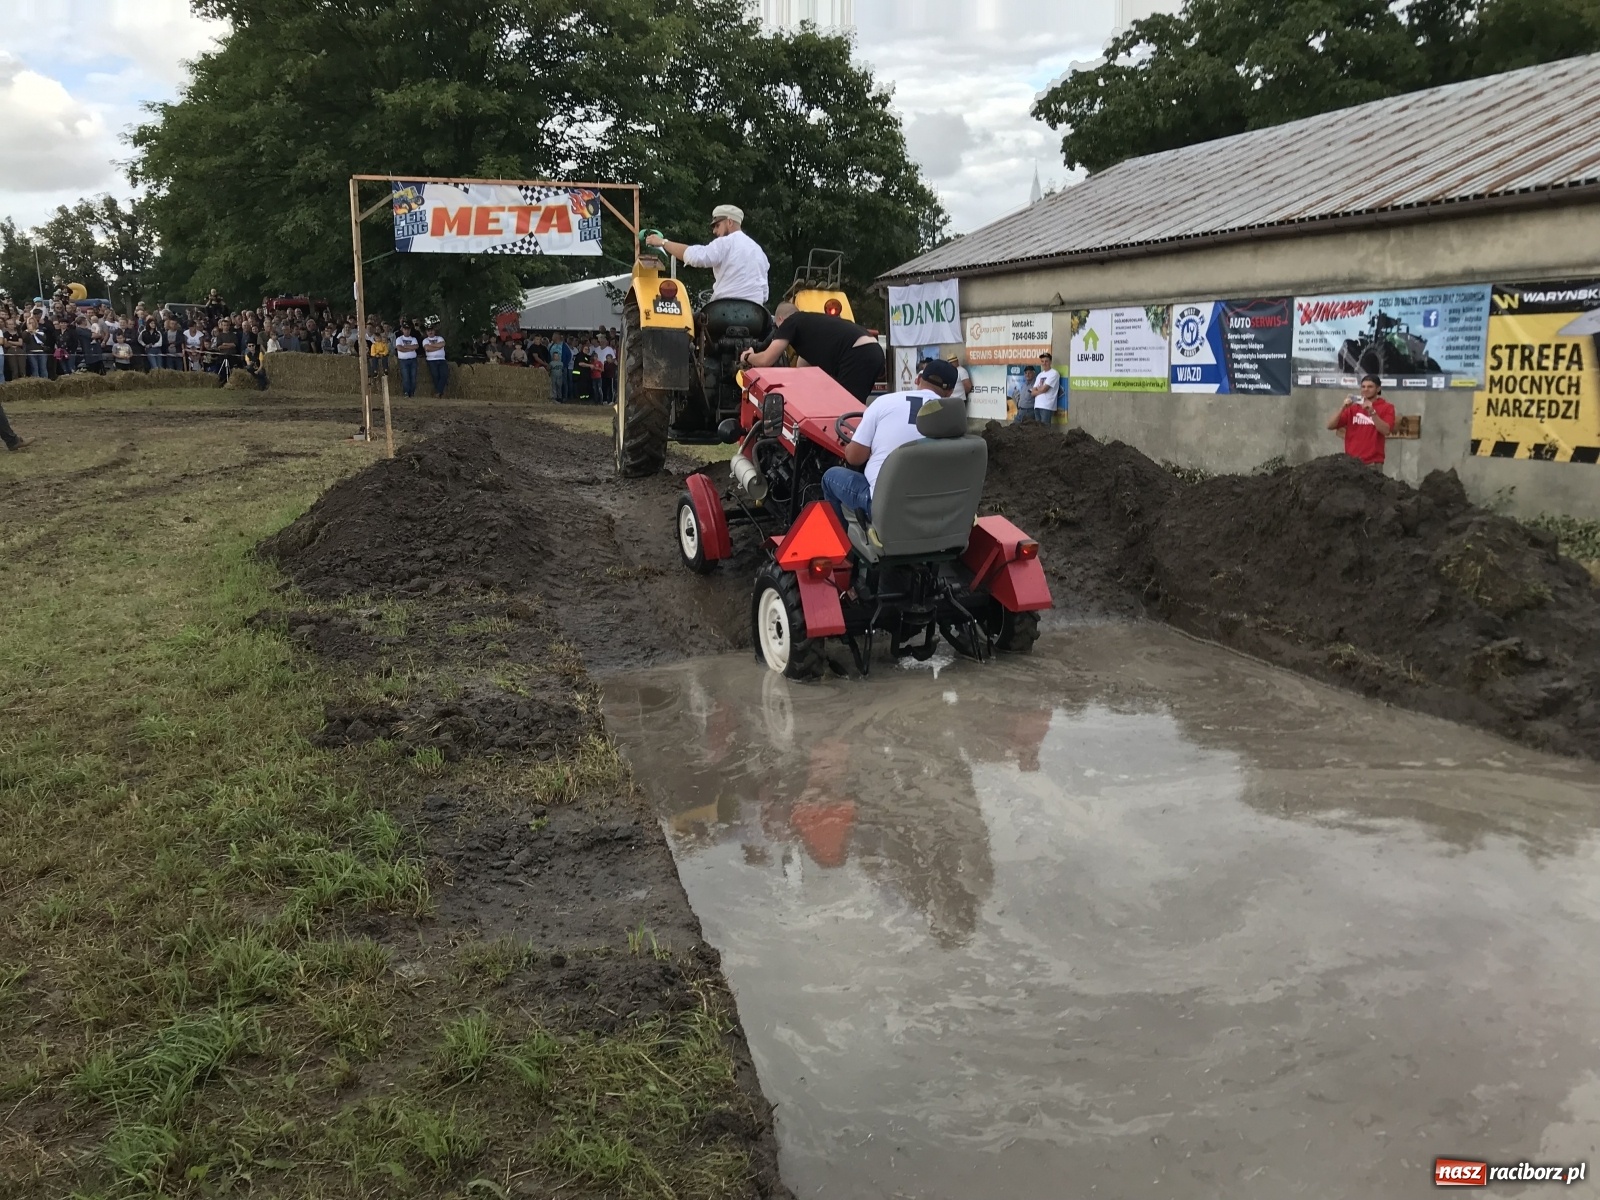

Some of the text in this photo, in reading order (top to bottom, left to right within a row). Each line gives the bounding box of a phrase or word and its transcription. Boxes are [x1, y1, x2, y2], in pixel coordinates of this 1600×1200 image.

[430, 205, 573, 237] META
[579, 228, 602, 242] RA
[1523, 288, 1600, 302] WARYNSK
[902, 298, 955, 326] DANKO
[1012, 319, 1034, 328] kontakt:
[969, 349, 993, 360] SERWIS
[1077, 353, 1105, 362] LEW-BUD
[1489, 343, 1584, 372] STREFA
[1177, 367, 1202, 382] WJAZD
[991, 386, 1005, 394] FM
[1488, 374, 1581, 396] MOCNYCH
[1486, 398, 1580, 423] NARZĘDZI
